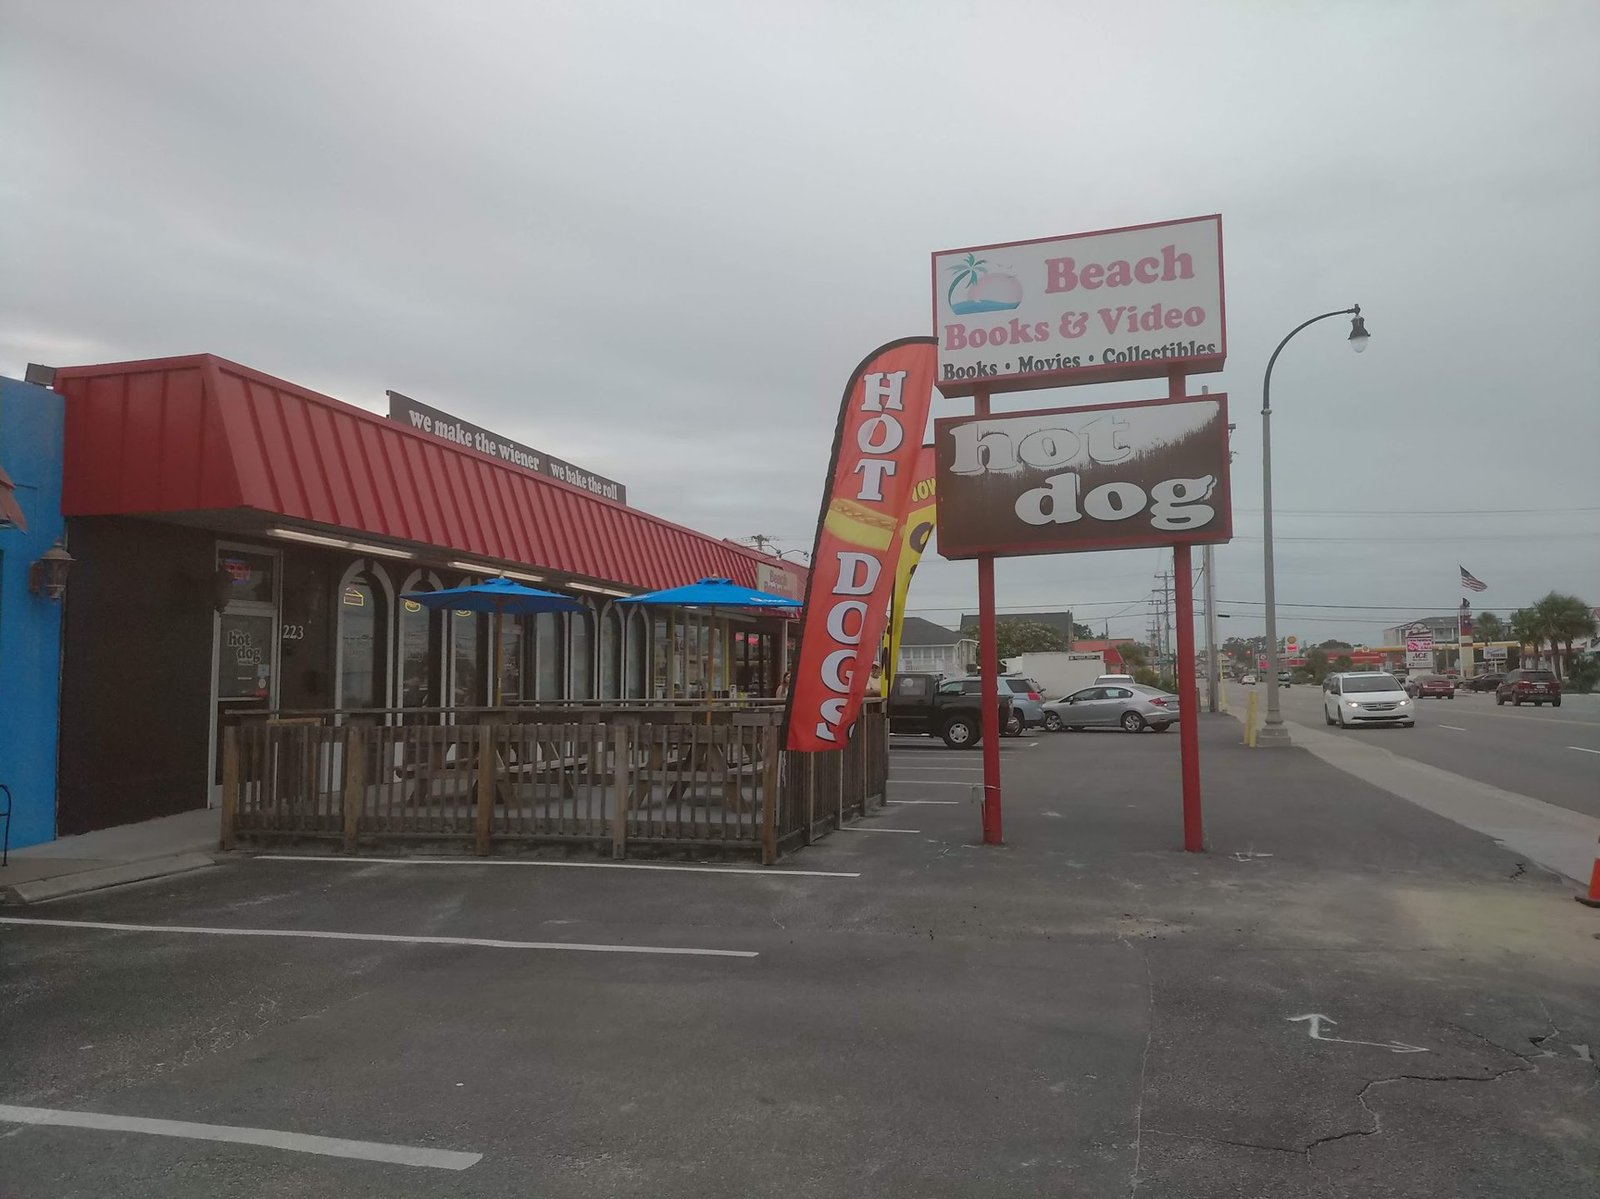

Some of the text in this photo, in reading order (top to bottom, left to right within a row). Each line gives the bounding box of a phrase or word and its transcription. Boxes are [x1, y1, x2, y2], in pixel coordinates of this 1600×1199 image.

[1044, 244, 1195, 295] Beach
[944, 303, 1206, 351] Books & Video
[943, 341, 1216, 380] Books Movies Collectibles
[409, 409, 540, 471] we make the wiener
[853, 370, 907, 502] HOT
[949, 414, 1132, 474] hot
[550, 462, 618, 501] we bake the roll
[1015, 472, 1217, 531] dog
[227, 628, 251, 647] hot
[237, 646, 261, 665] dog
[282, 625, 304, 640] 223
[816, 552, 882, 742] DOGS
